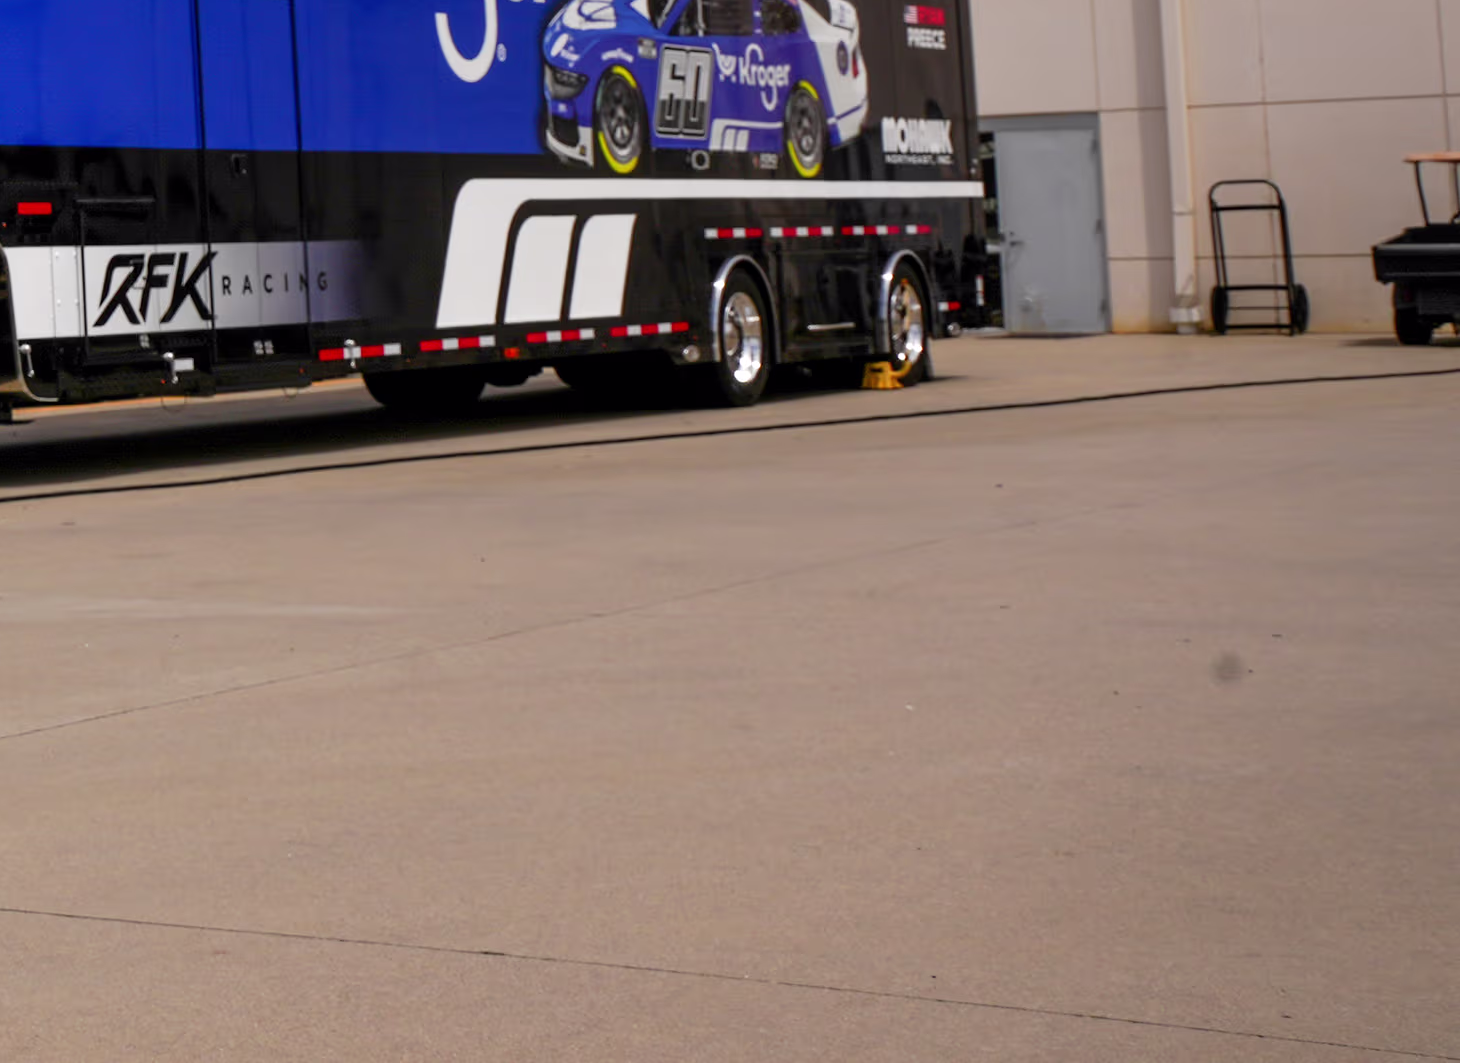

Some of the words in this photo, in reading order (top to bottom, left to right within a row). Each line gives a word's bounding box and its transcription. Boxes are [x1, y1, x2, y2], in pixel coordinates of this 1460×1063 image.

[656, 44, 712, 140] 60
[738, 43, 791, 111] Kroger
[93, 251, 218, 327] RFK
[222, 271, 328, 296] RACING
